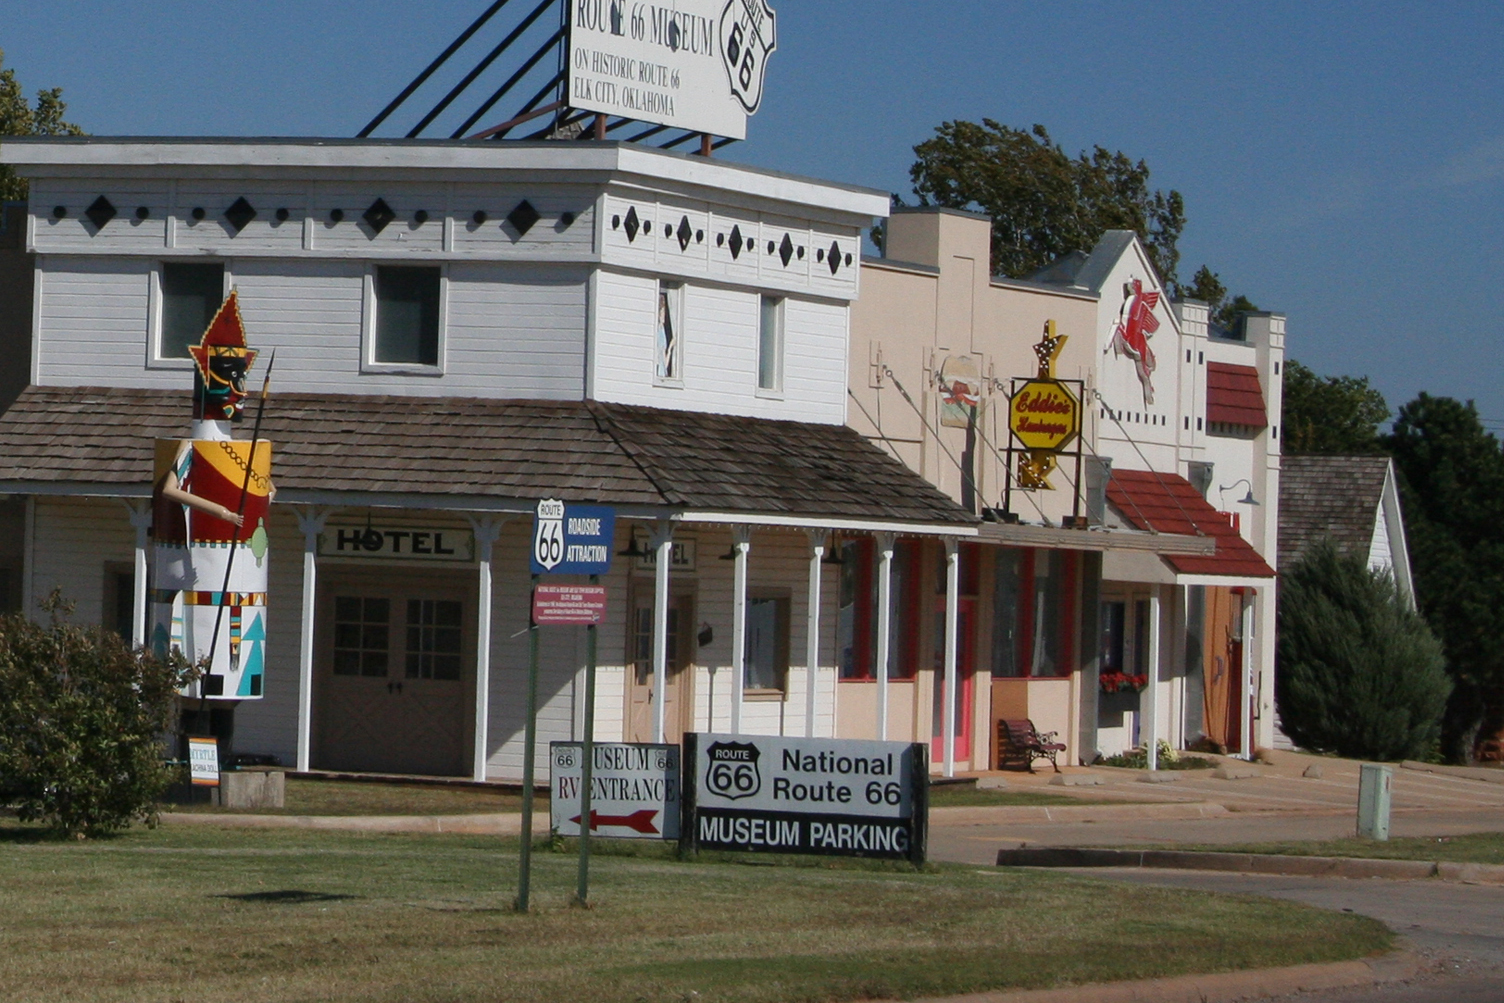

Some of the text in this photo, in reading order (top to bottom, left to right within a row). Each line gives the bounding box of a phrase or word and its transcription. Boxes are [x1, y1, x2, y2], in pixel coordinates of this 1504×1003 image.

[630, 2, 645, 41] 66
[650, 6, 714, 56] MUSEUM
[574, 48, 680, 89] ON HISTORIC ROUTE 66
[727, 22, 755, 92] 66
[574, 78, 674, 116] ELK CITY, OKLAHOMA
[540, 504, 561, 516] ROUTE
[567, 517, 601, 536] ROADSIDE
[337, 529, 454, 555] HOTEL
[539, 522, 560, 562] 66
[566, 545, 607, 562] ATTRACTION
[643, 542, 689, 564] HEL
[557, 755, 574, 767] 66
[581, 747, 649, 770] USEUM
[657, 757, 674, 769] 66
[715, 748, 749, 760] ROUTE
[782, 749, 893, 775] National
[558, 777, 675, 802] RV ENTRANCE
[713, 763, 754, 792] 66
[773, 777, 902, 806] Route 66
[700, 816, 909, 852] MUSEUM PARKING
